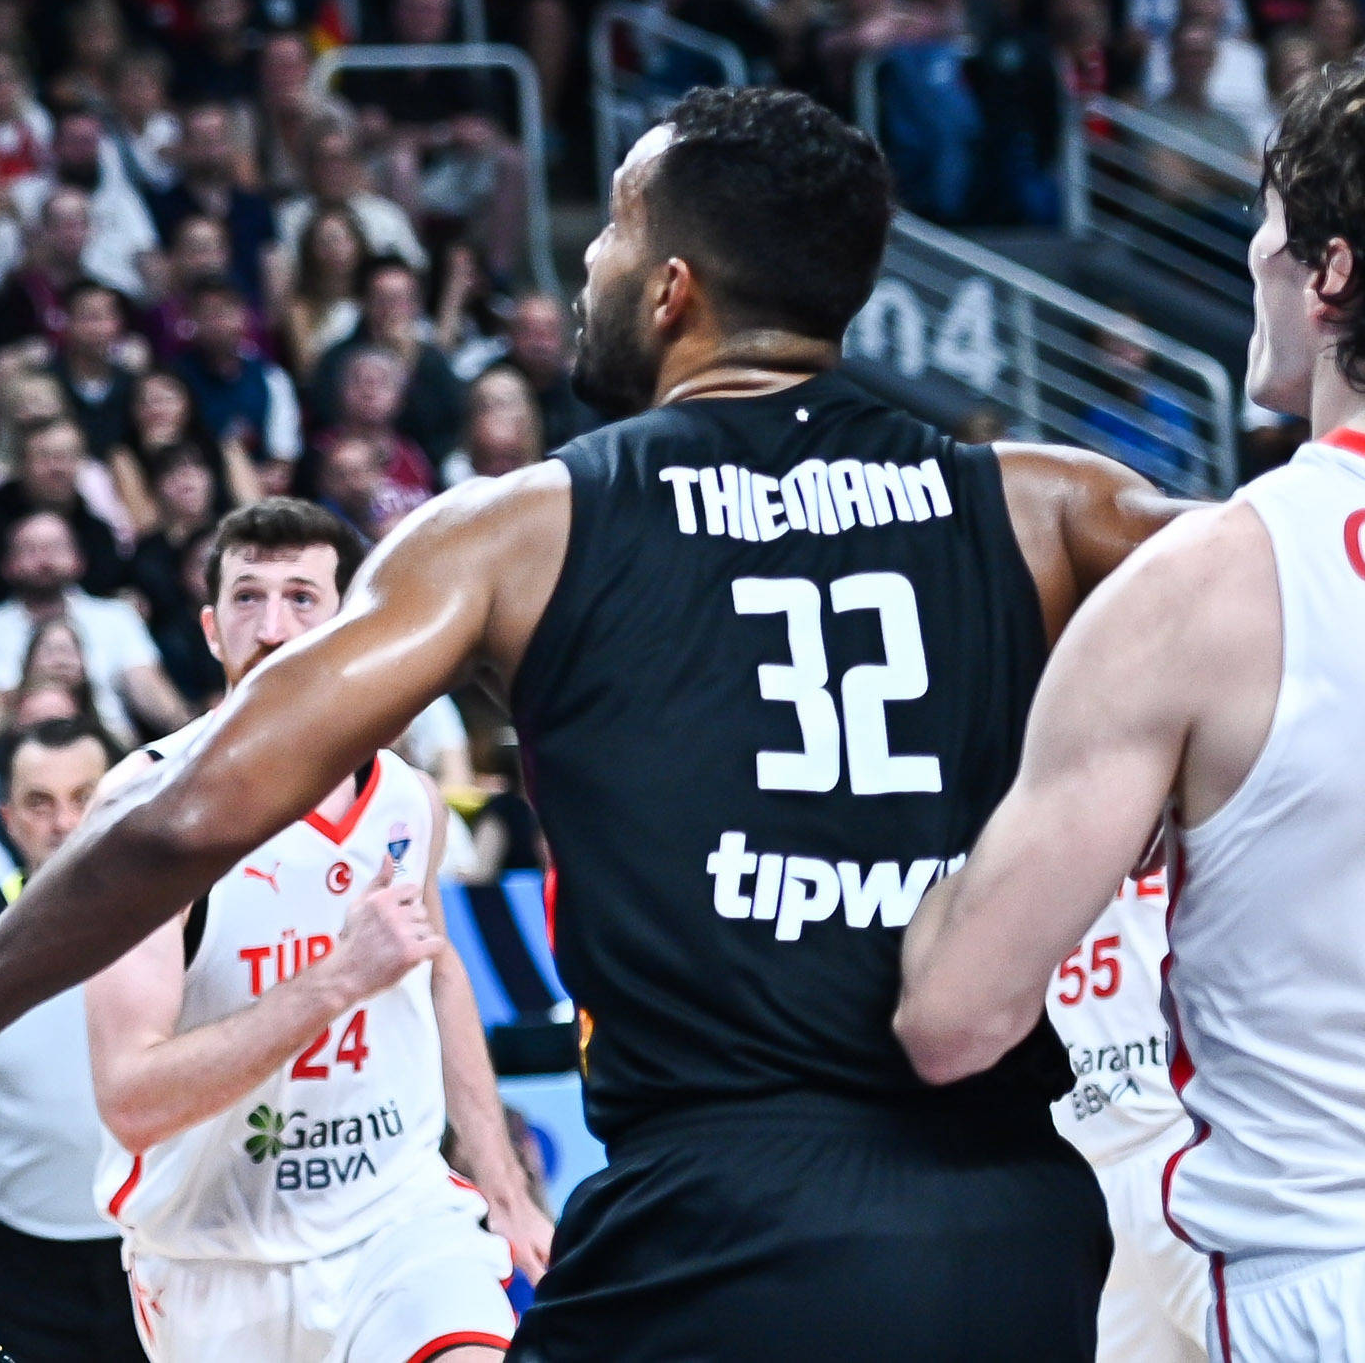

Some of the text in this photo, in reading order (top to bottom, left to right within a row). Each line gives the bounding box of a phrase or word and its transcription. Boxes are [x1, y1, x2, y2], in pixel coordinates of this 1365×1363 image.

[659, 458, 953, 542] THIEMANN
[731, 571, 943, 795] 32
[706, 830, 967, 941] tipw
[1059, 935, 1121, 1006] 55
[291, 1009, 369, 1080] 24
[280, 1100, 404, 1150] Garanti
[276, 1151, 377, 1191] BBVA
